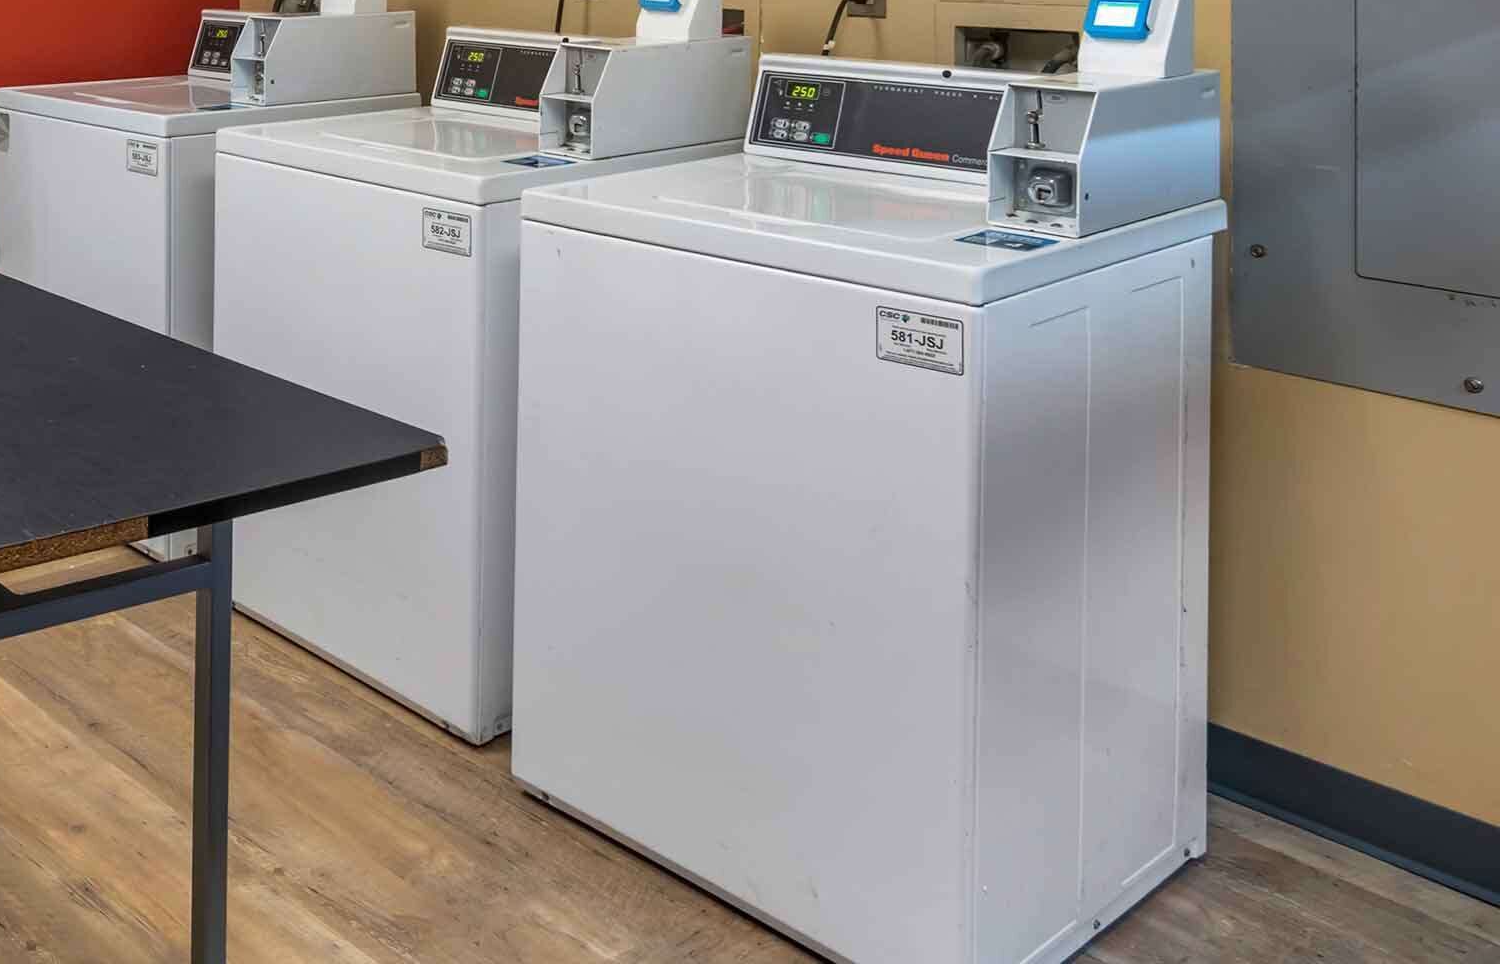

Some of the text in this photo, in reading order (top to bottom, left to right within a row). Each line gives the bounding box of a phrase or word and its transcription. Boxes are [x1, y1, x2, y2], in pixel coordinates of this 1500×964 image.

[467, 51, 485, 62] 250
[791, 85, 816, 98] 250
[871, 143, 910, 157] Speed
[911, 147, 949, 162] Queen
[430, 224, 461, 238] 582-JSJ
[879, 310, 901, 320] CSC
[891, 330, 944, 350] 581-JSJ
